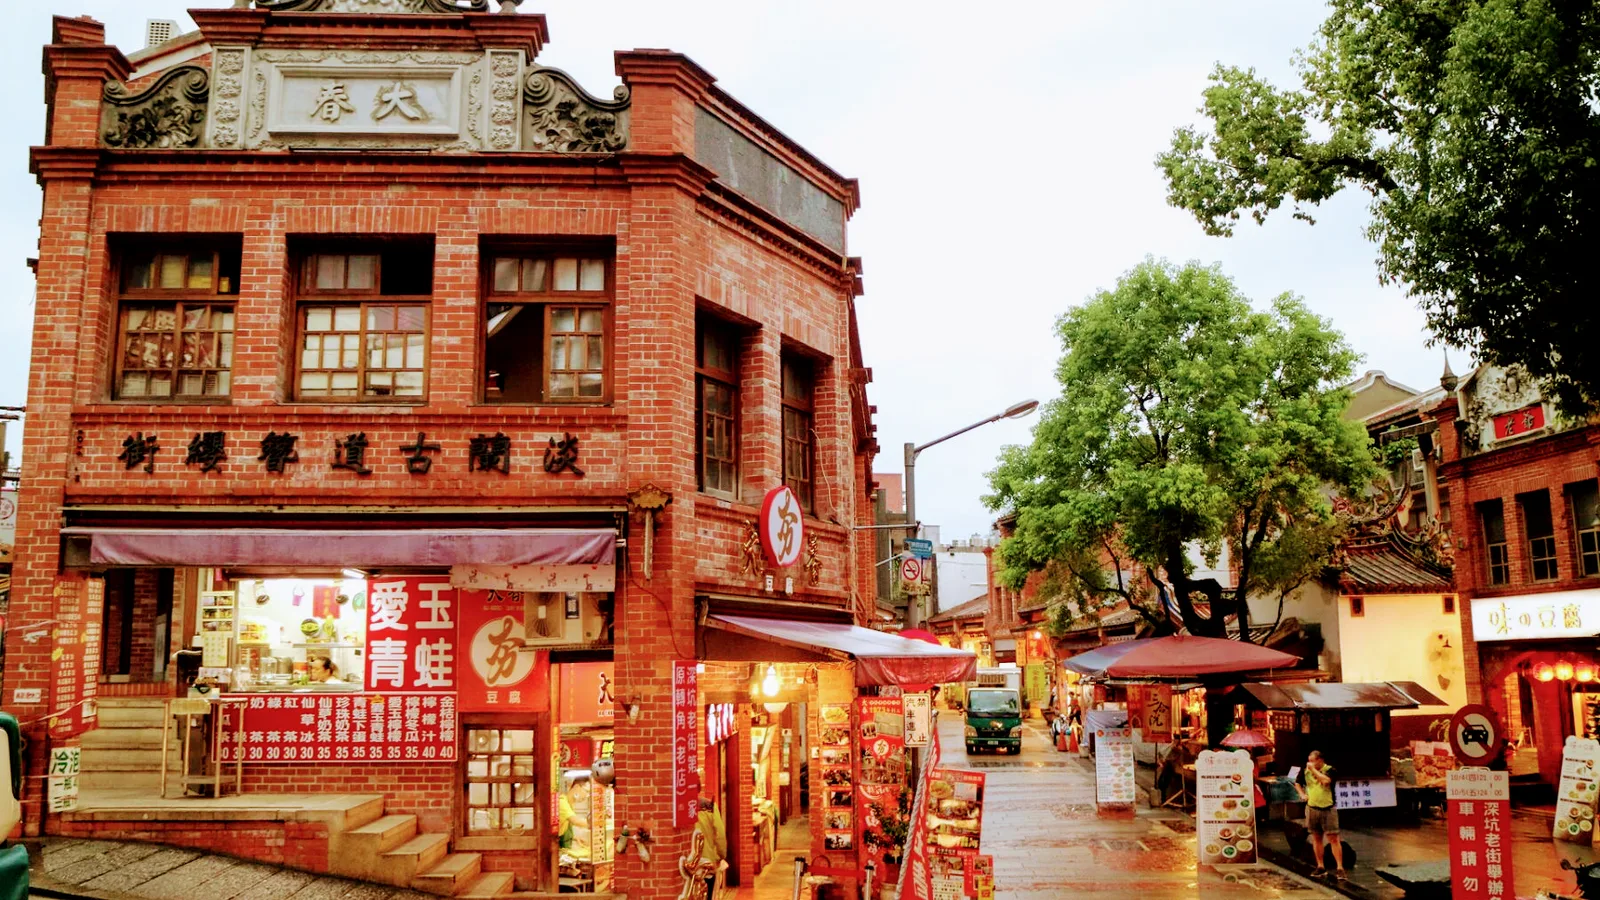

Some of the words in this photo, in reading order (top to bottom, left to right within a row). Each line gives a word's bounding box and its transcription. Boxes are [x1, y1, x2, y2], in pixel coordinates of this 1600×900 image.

[369, 580, 455, 632] 愛玉
[1489, 602, 1582, 634] 味の豆腐
[368, 636, 454, 688] 青蛙
[249, 697, 265, 743] 奶茶
[284, 697, 298, 743] 紅茶
[300, 697, 316, 743] 仙草冰
[317, 697, 332, 743] 仙草奶茶
[335, 696, 350, 742] 珍珠奶茶
[387, 696, 402, 742] 愛玉檸檬
[405, 696, 420, 742] 檸檬冬瓜
[422, 696, 437, 742] 檸檬汁
[439, 696, 455, 742] 金桔檸檬
[486, 691, 521, 704] 豆腐
[906, 697, 916, 743] 汽車進入
[917, 697, 928, 743] 禁止
[249, 746, 263, 759] 30
[266, 746, 280, 759] 30
[283, 746, 297, 759] 30
[300, 746, 314, 759] 30
[317, 746, 331, 759] 35
[335, 746, 349, 759] 35
[352, 746, 366, 759] 35
[369, 746, 383, 759] 35
[387, 746, 401, 759] 35
[405, 746, 419, 759] 35
[422, 745, 436, 758] 40
[440, 745, 454, 758] 40
[686, 666, 698, 819] 深坑老街第一家
[1484, 802, 1504, 900] 深坑老街舉辦
